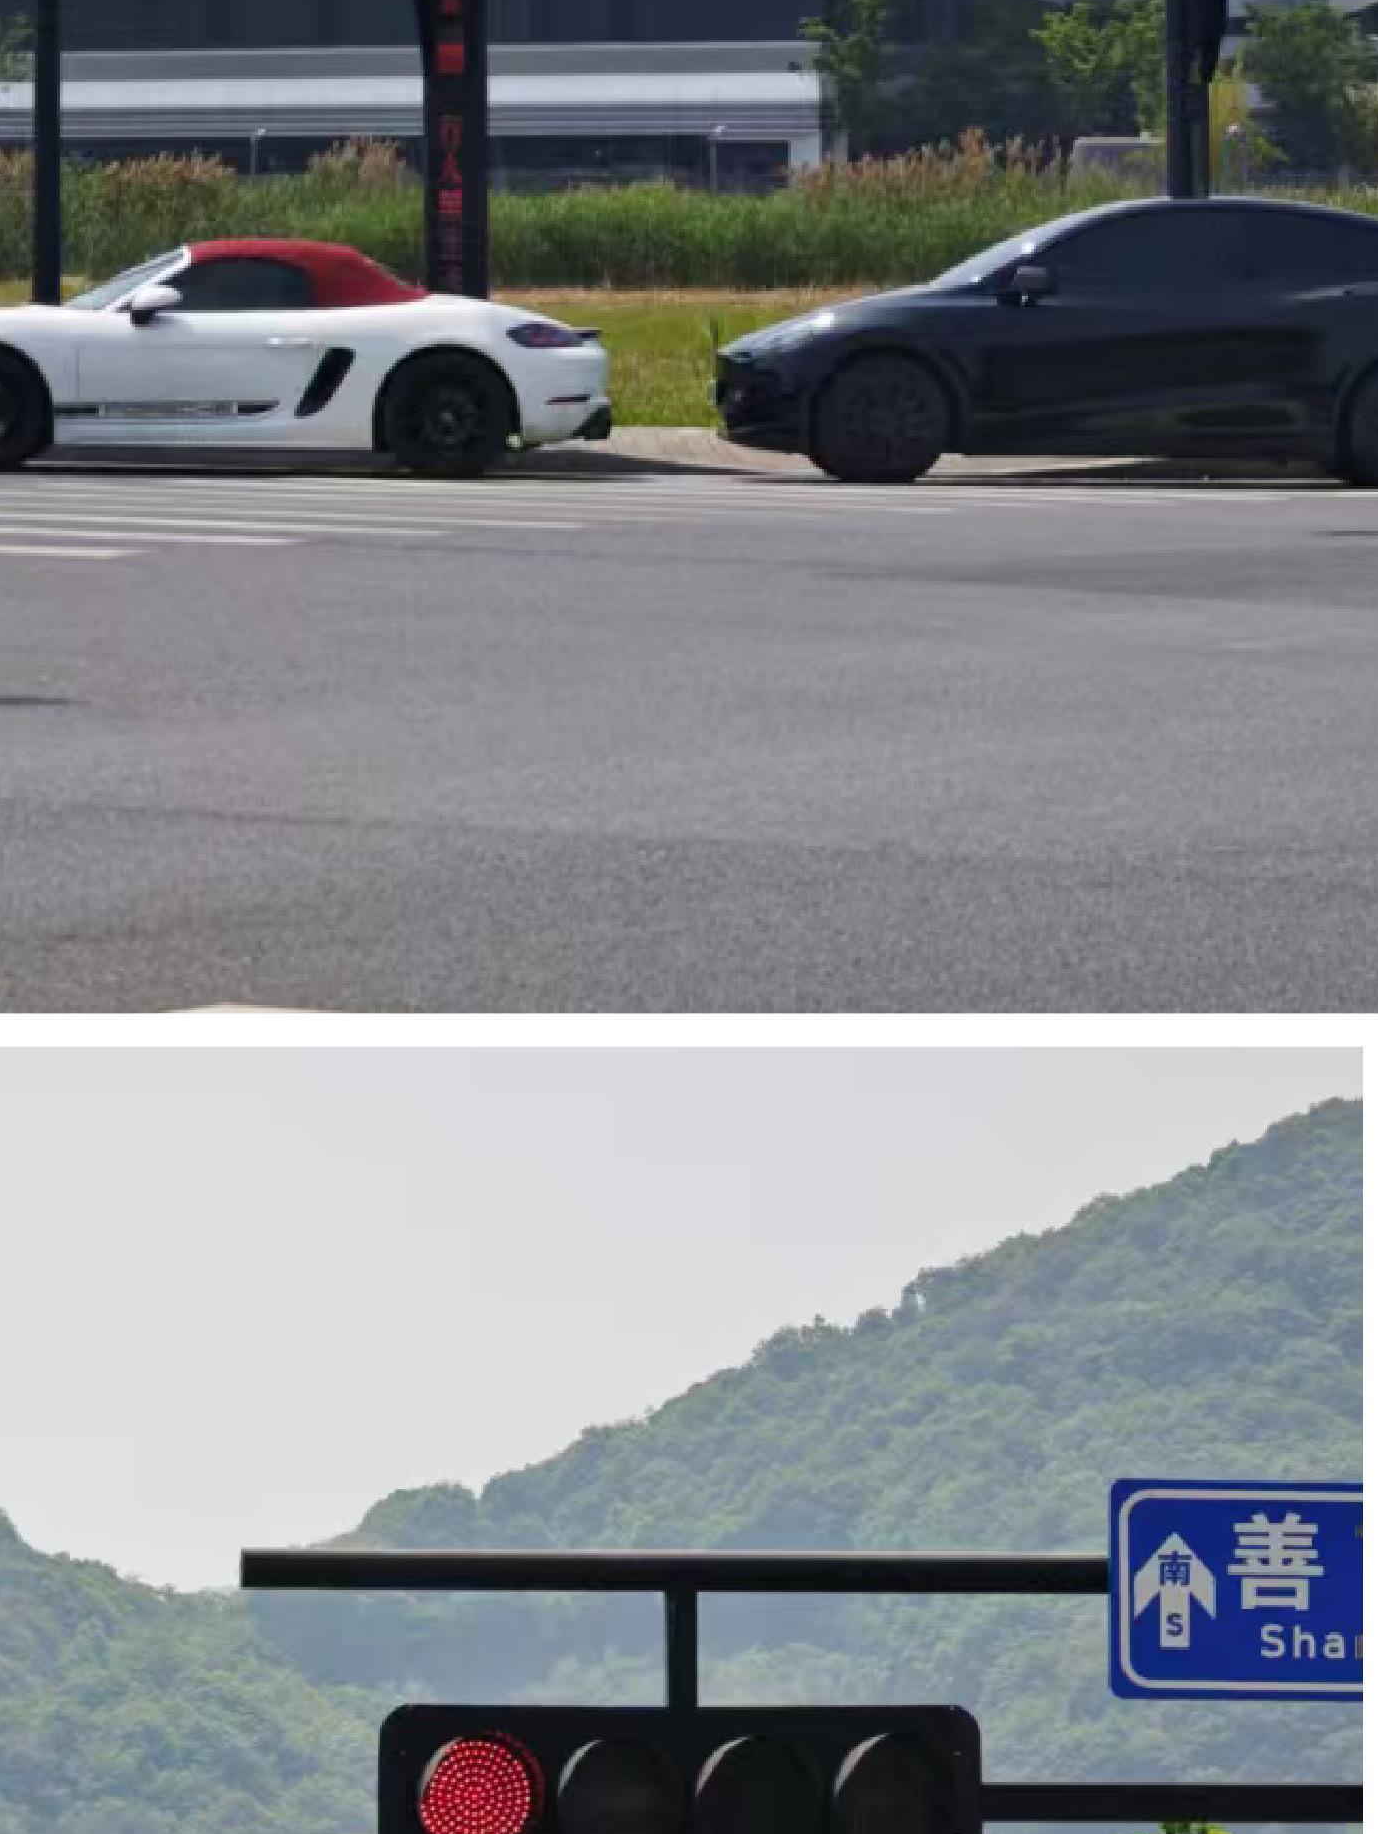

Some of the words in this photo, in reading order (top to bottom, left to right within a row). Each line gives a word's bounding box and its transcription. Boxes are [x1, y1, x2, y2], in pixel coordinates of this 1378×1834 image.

[1157, 1550, 1193, 1587] 南
[1227, 1512, 1363, 1611] 善
[1166, 1612, 1185, 1638] S
